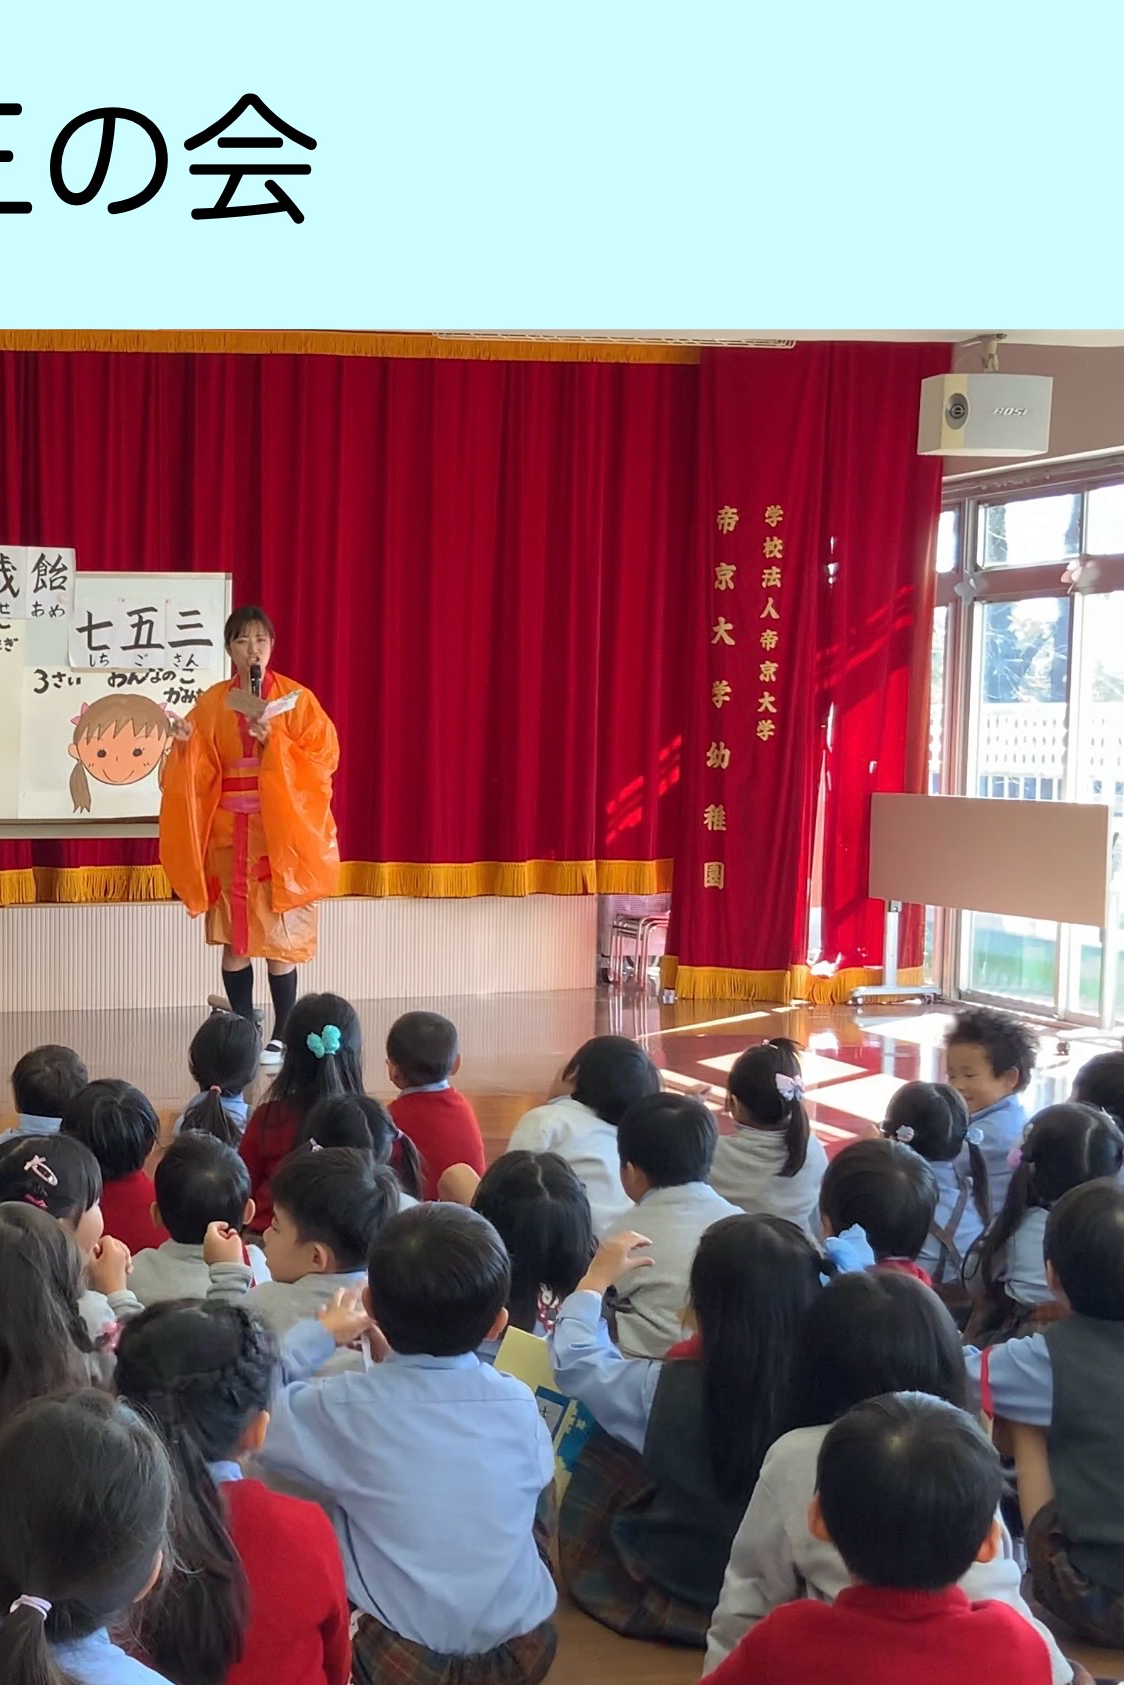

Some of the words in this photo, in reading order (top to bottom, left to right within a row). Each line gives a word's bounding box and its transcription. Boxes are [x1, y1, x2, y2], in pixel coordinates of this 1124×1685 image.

[33, 668, 82, 694] 3さい
[75, 606, 214, 651] 七五三
[756, 504, 784, 742] 学校法人帝京大学
[703, 505, 740, 890] 帝京大学幼稚園
